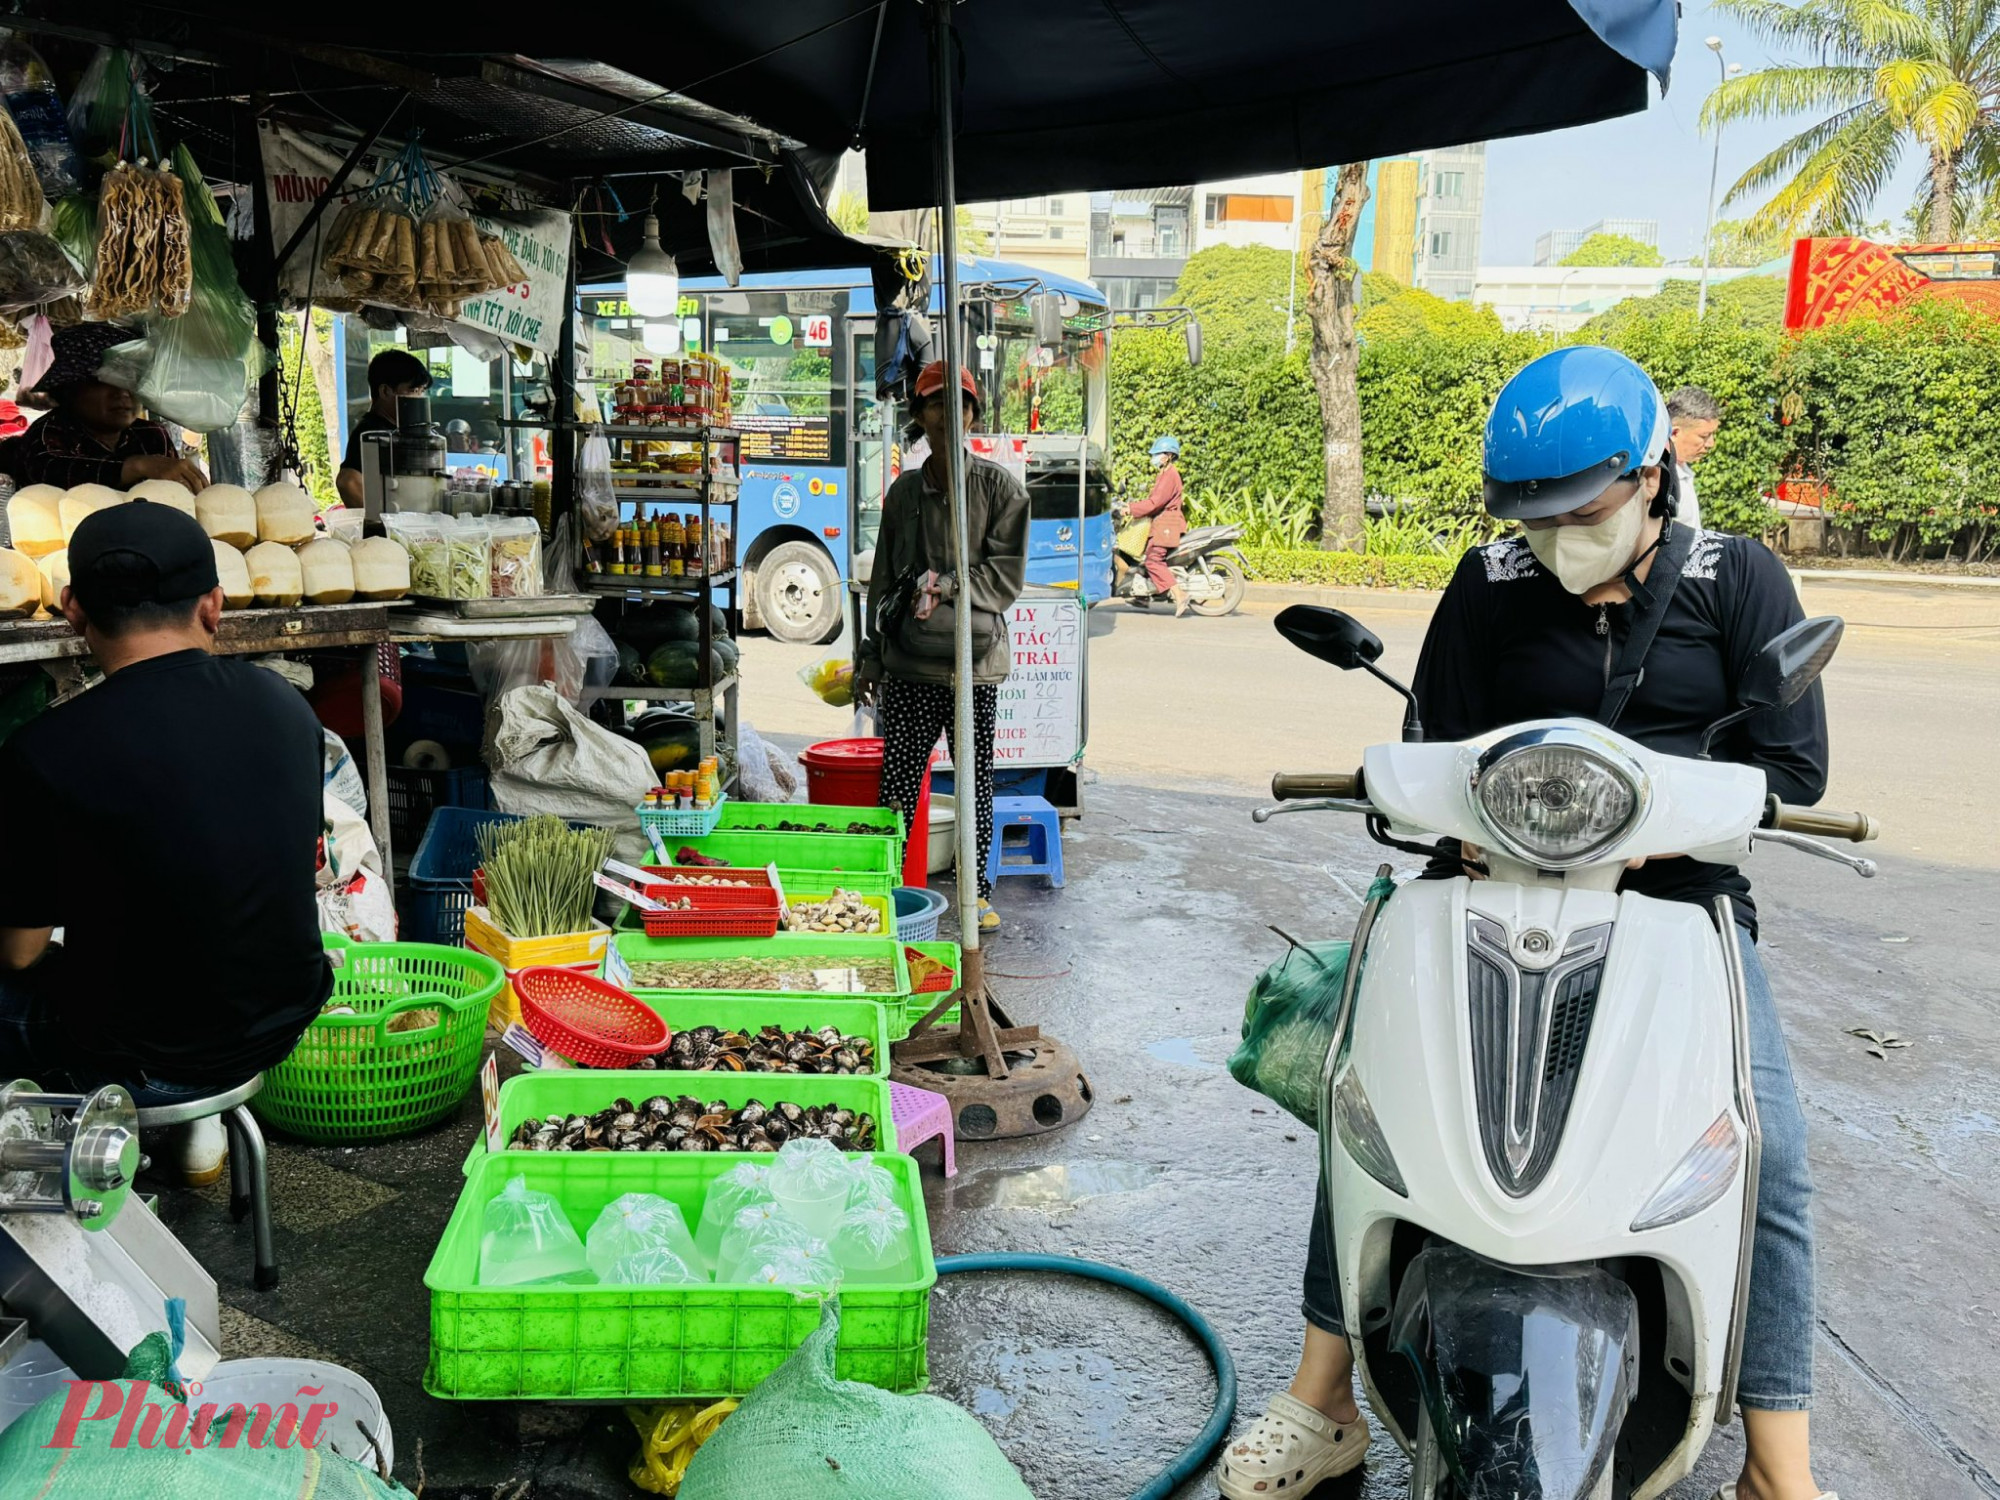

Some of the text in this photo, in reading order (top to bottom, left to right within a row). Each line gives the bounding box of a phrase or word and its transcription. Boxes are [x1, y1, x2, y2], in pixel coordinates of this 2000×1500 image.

[541, 242, 555, 274] XÔI
[596, 300, 617, 316] XE
[504, 306, 523, 336] XÔI
[521, 315, 543, 343] CHÈ
[809, 320, 828, 340] 46
[1015, 608, 1037, 622] LY
[1014, 624, 1077, 645] TẮC 17
[1013, 647, 1059, 665] TRÁI
[1026, 668, 1048, 682] LÀM
[1049, 668, 1073, 682] MỨC
[1035, 683, 1058, 699] 20
